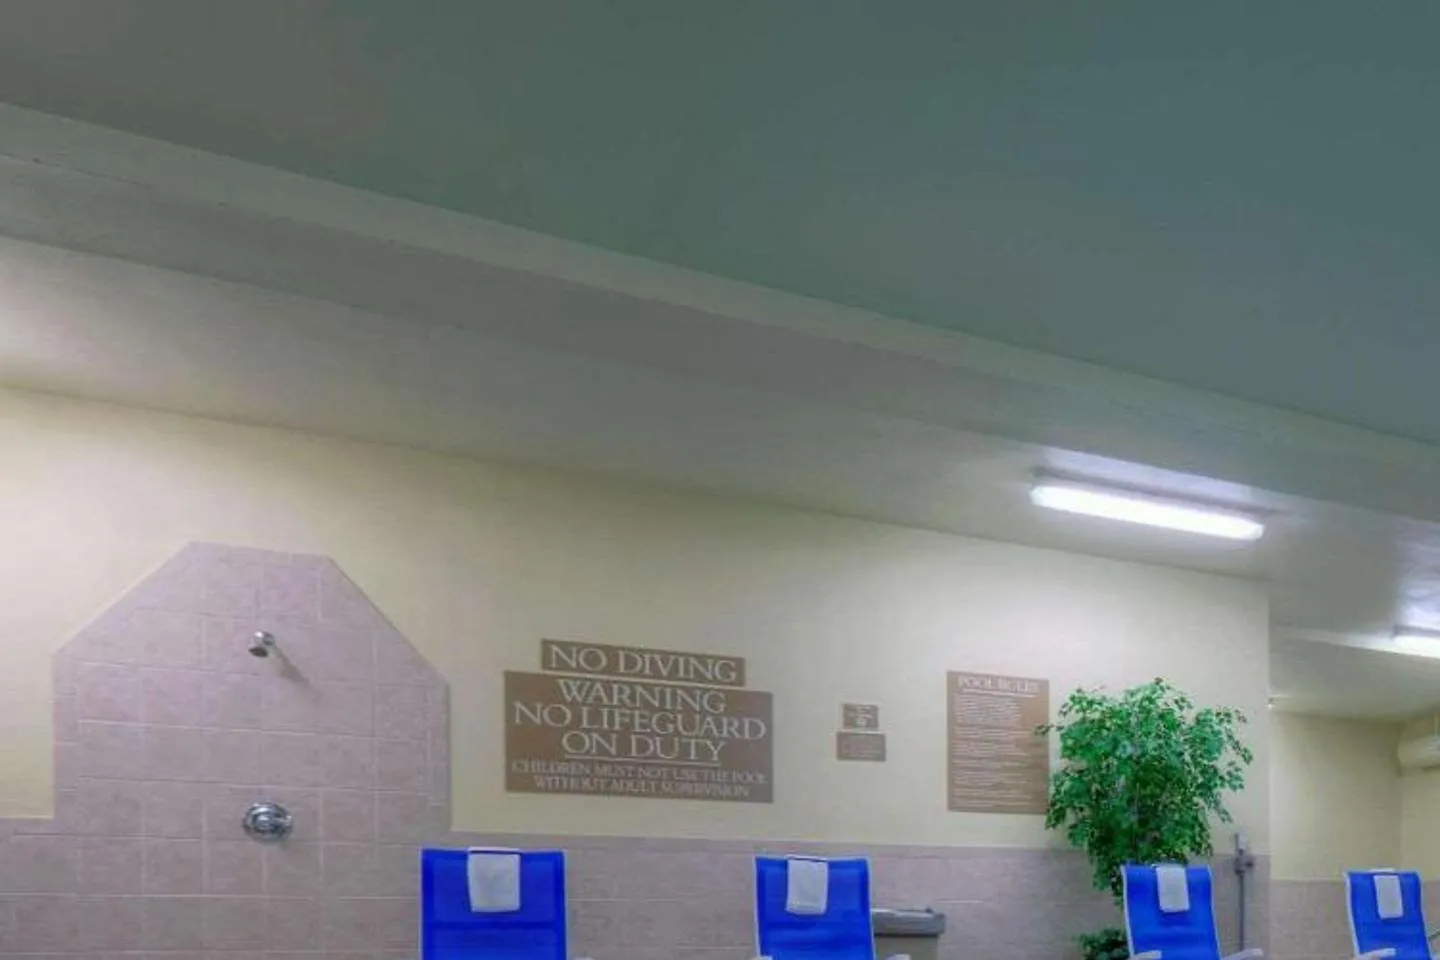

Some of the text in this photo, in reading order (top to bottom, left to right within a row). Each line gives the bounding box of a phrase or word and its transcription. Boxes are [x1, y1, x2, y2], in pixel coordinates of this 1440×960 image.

[550, 644, 737, 682] NO DIVING
[558, 679, 726, 714] WARNING
[513, 701, 767, 740] NO LIFEGUARD
[562, 731, 728, 762] ON DUTY
[511, 759, 591, 775] CHILDREN
[638, 762, 669, 776] NOT
